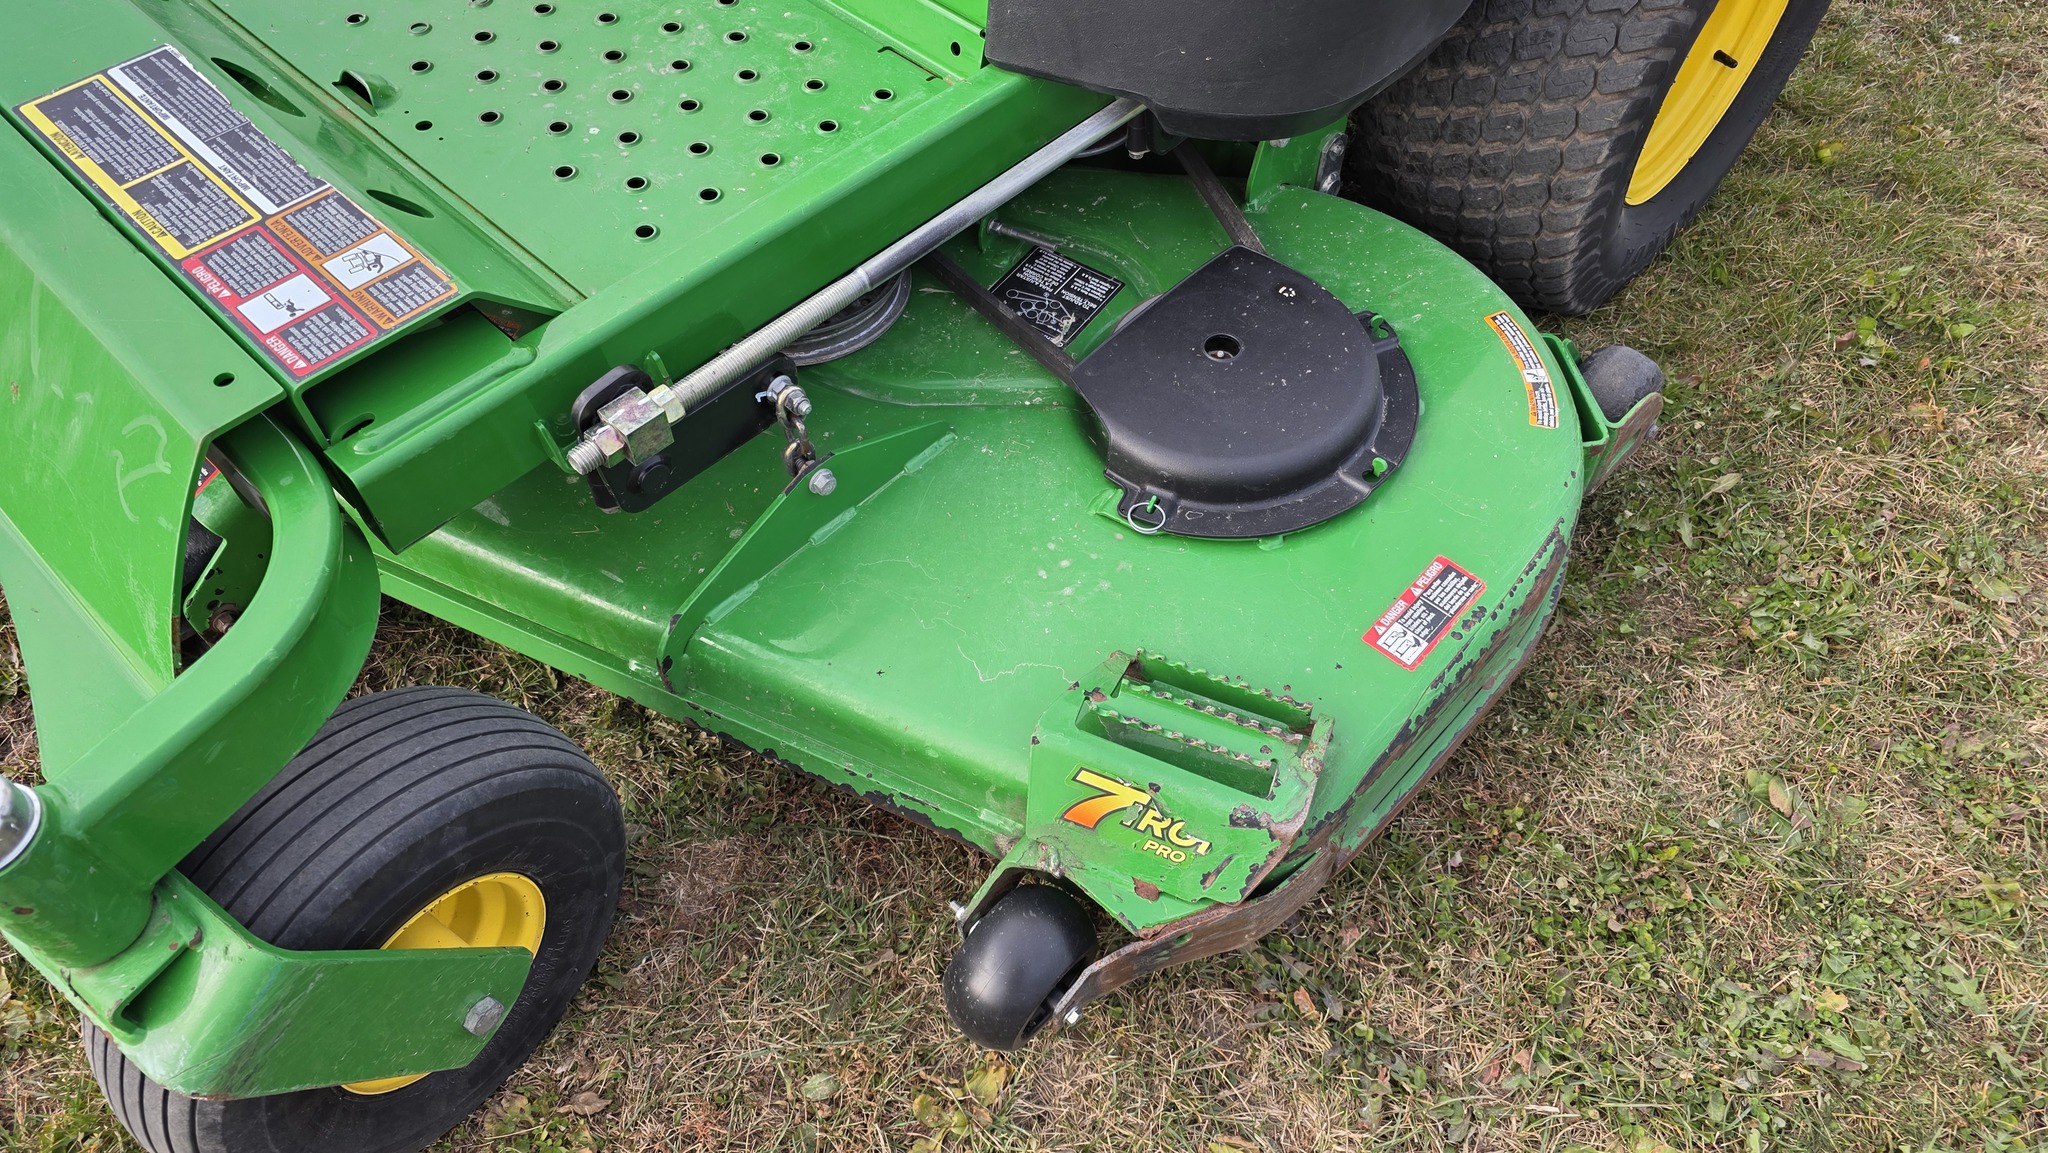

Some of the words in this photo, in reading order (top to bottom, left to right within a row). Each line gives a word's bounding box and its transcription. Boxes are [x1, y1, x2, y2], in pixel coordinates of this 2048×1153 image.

[137, 94, 170, 120] IMPORTANTE
[217, 164, 250, 190] IMPORTANT
[132, 209, 162, 234] CAUTION
[269, 219, 315, 256] ADVERTENCIA
[190, 265, 224, 292] PELIGRO
[351, 291, 388, 320] WARNING
[1060, 288, 1084, 303] TENSION
[1061, 293, 1082, 306] ADJUST
[1083, 299, 1098, 308] BELT
[264, 335, 299, 363] DANGER
[1415, 561, 1442, 587] PELIGRO
[1380, 599, 1408, 626] DANGER
[1142, 839, 1187, 863] PRO
